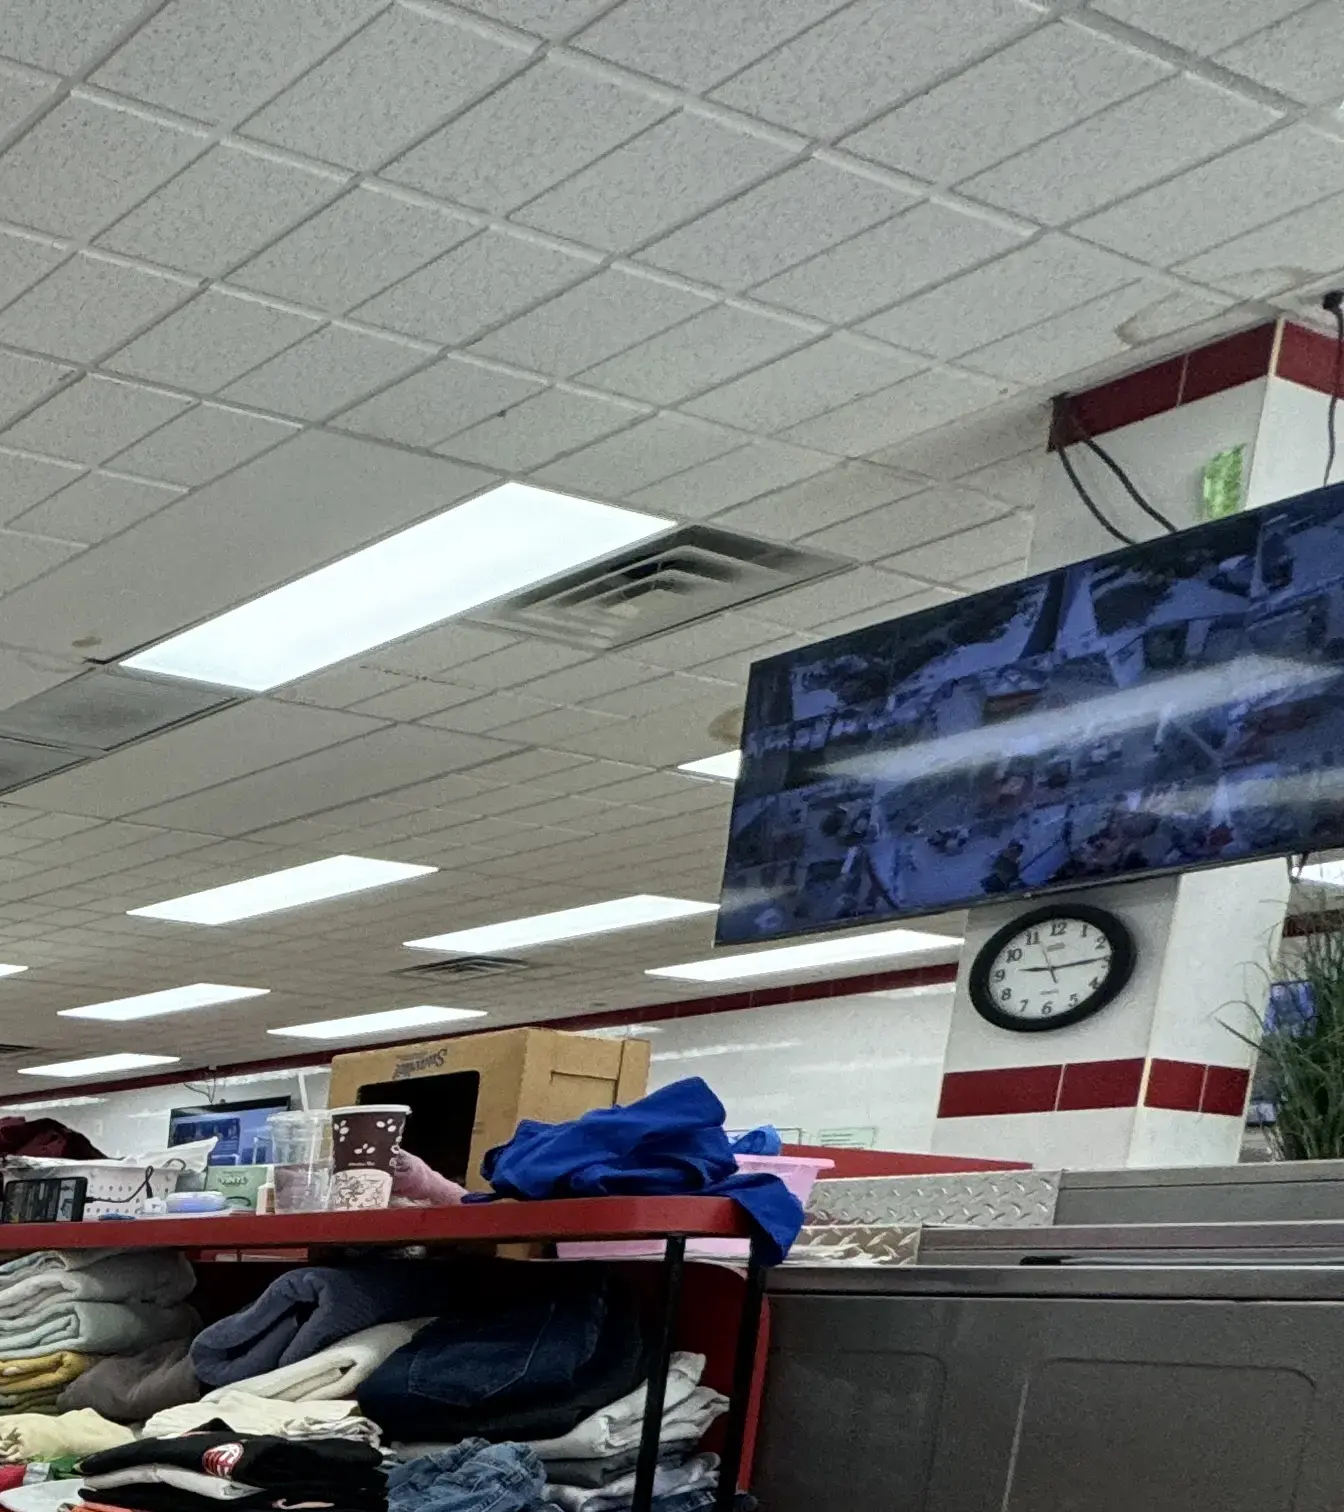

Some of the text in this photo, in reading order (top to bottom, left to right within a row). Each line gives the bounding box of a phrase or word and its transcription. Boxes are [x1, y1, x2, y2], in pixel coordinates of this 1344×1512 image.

[1050, 922, 1068, 936] 12
[1081, 924, 1088, 937] 1
[1026, 931, 1039, 945] 11
[1095, 936, 1106, 949] 2
[1005, 949, 1023, 963] 10
[994, 969, 1006, 982] 9
[1088, 976, 1101, 990] 4
[1001, 988, 1012, 1001] 8
[1068, 993, 1078, 1007] 5
[1020, 999, 1029, 1012] 7
[1041, 1001, 1052, 1014] 6
